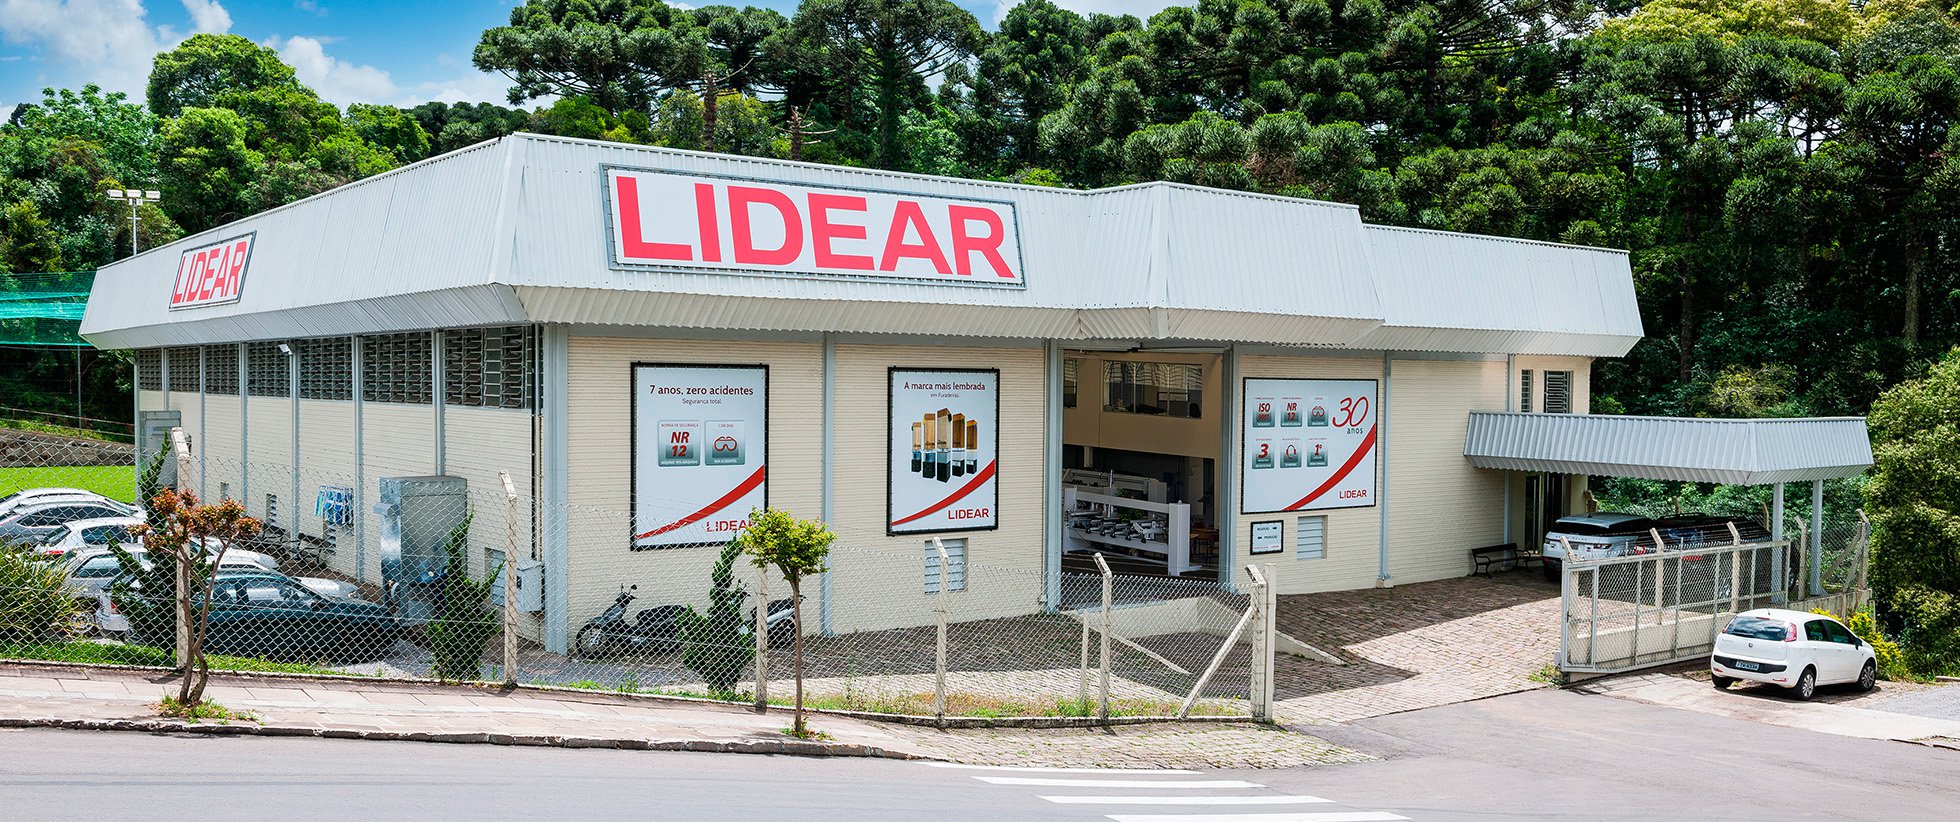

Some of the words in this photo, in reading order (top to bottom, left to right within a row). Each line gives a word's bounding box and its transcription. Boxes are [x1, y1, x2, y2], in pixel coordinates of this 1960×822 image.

[616, 176, 1016, 279] LIDEAR
[172, 241, 247, 304] LIDEAR
[649, 384, 656, 395] 7
[658, 386, 684, 396] anos,
[686, 386, 708, 395] zero
[709, 385, 754, 395] acidentes
[903, 381, 910, 390] A
[934, 382, 951, 390] mais
[952, 382, 986, 390] lembrada
[682, 398, 709, 406] Segurança
[1258, 402, 1271, 413] ISO
[1286, 402, 1298, 411] NR
[1287, 411, 1296, 422] 12
[1332, 396, 1369, 428] 30
[670, 431, 690, 444] NR
[671, 444, 688, 457] 12
[1258, 443, 1269, 458] 3
[1339, 489, 1367, 499] LIDEAR
[948, 508, 989, 520] LIDEAR
